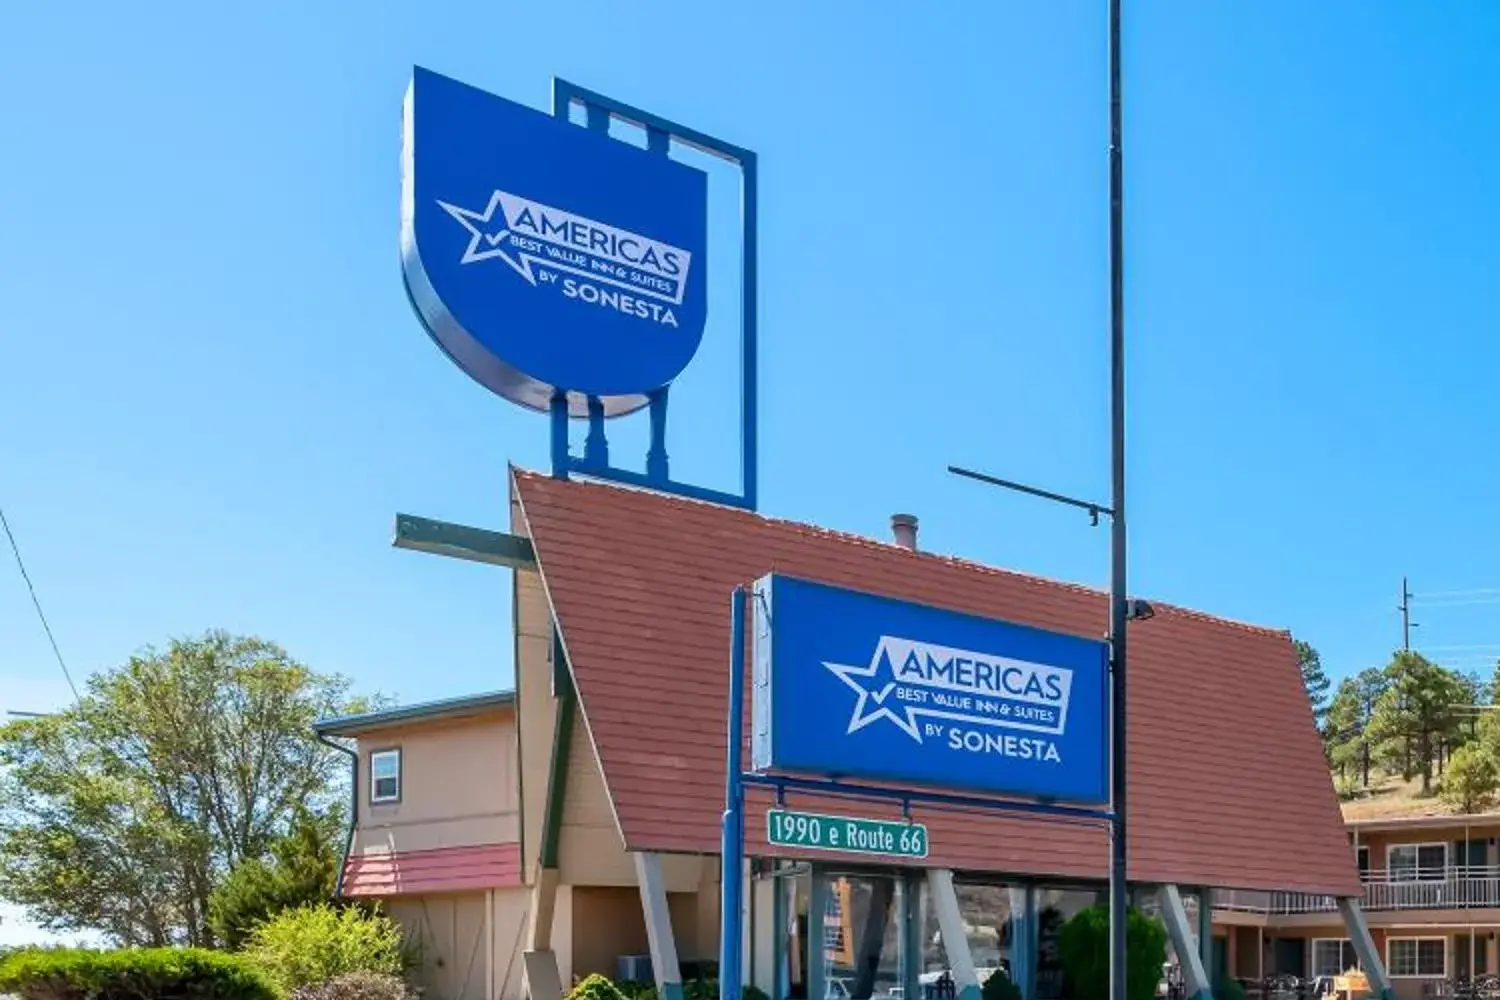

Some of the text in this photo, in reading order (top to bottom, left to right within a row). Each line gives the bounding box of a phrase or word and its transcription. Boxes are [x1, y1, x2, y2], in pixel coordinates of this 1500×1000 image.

[510, 235, 542, 252] BEST
[546, 246, 587, 267] VALUE
[631, 272, 673, 293] SUITES
[514, 207, 681, 275] AMERICAS
[539, 270, 679, 328] BY SONESTA
[900, 650, 1062, 700] AMERICAS
[896, 687, 928, 702] BEST
[931, 693, 972, 710] VALUE
[1014, 705, 1054, 722] SUITES
[925, 723, 1062, 763] BY SONESTA
[775, 815, 921, 852] 1990 e Route 66
